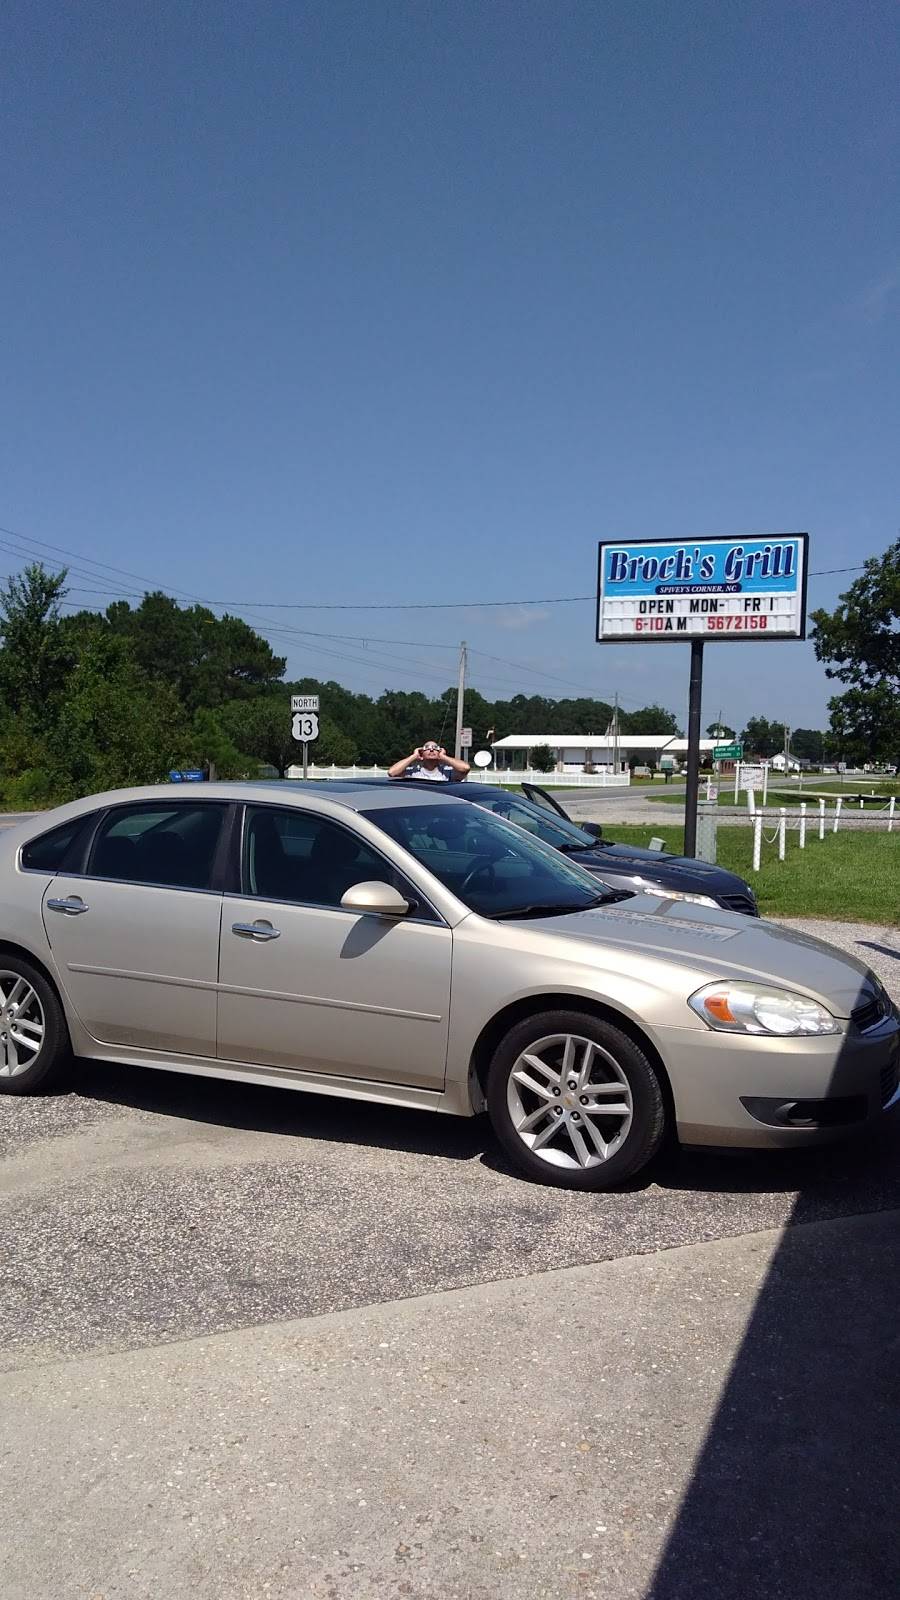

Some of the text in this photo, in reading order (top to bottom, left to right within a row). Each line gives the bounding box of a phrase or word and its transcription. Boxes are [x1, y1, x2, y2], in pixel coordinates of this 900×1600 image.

[608, 544, 795, 583] Brock's Grill
[660, 585, 690, 593] SPIVEY'S
[725, 584, 737, 592] NC
[639, 600, 674, 614] OPEN
[689, 598, 725, 613] MON-
[707, 615, 768, 630] 5672158
[293, 699, 317, 707] NORTH
[298, 720, 312, 736] 13
